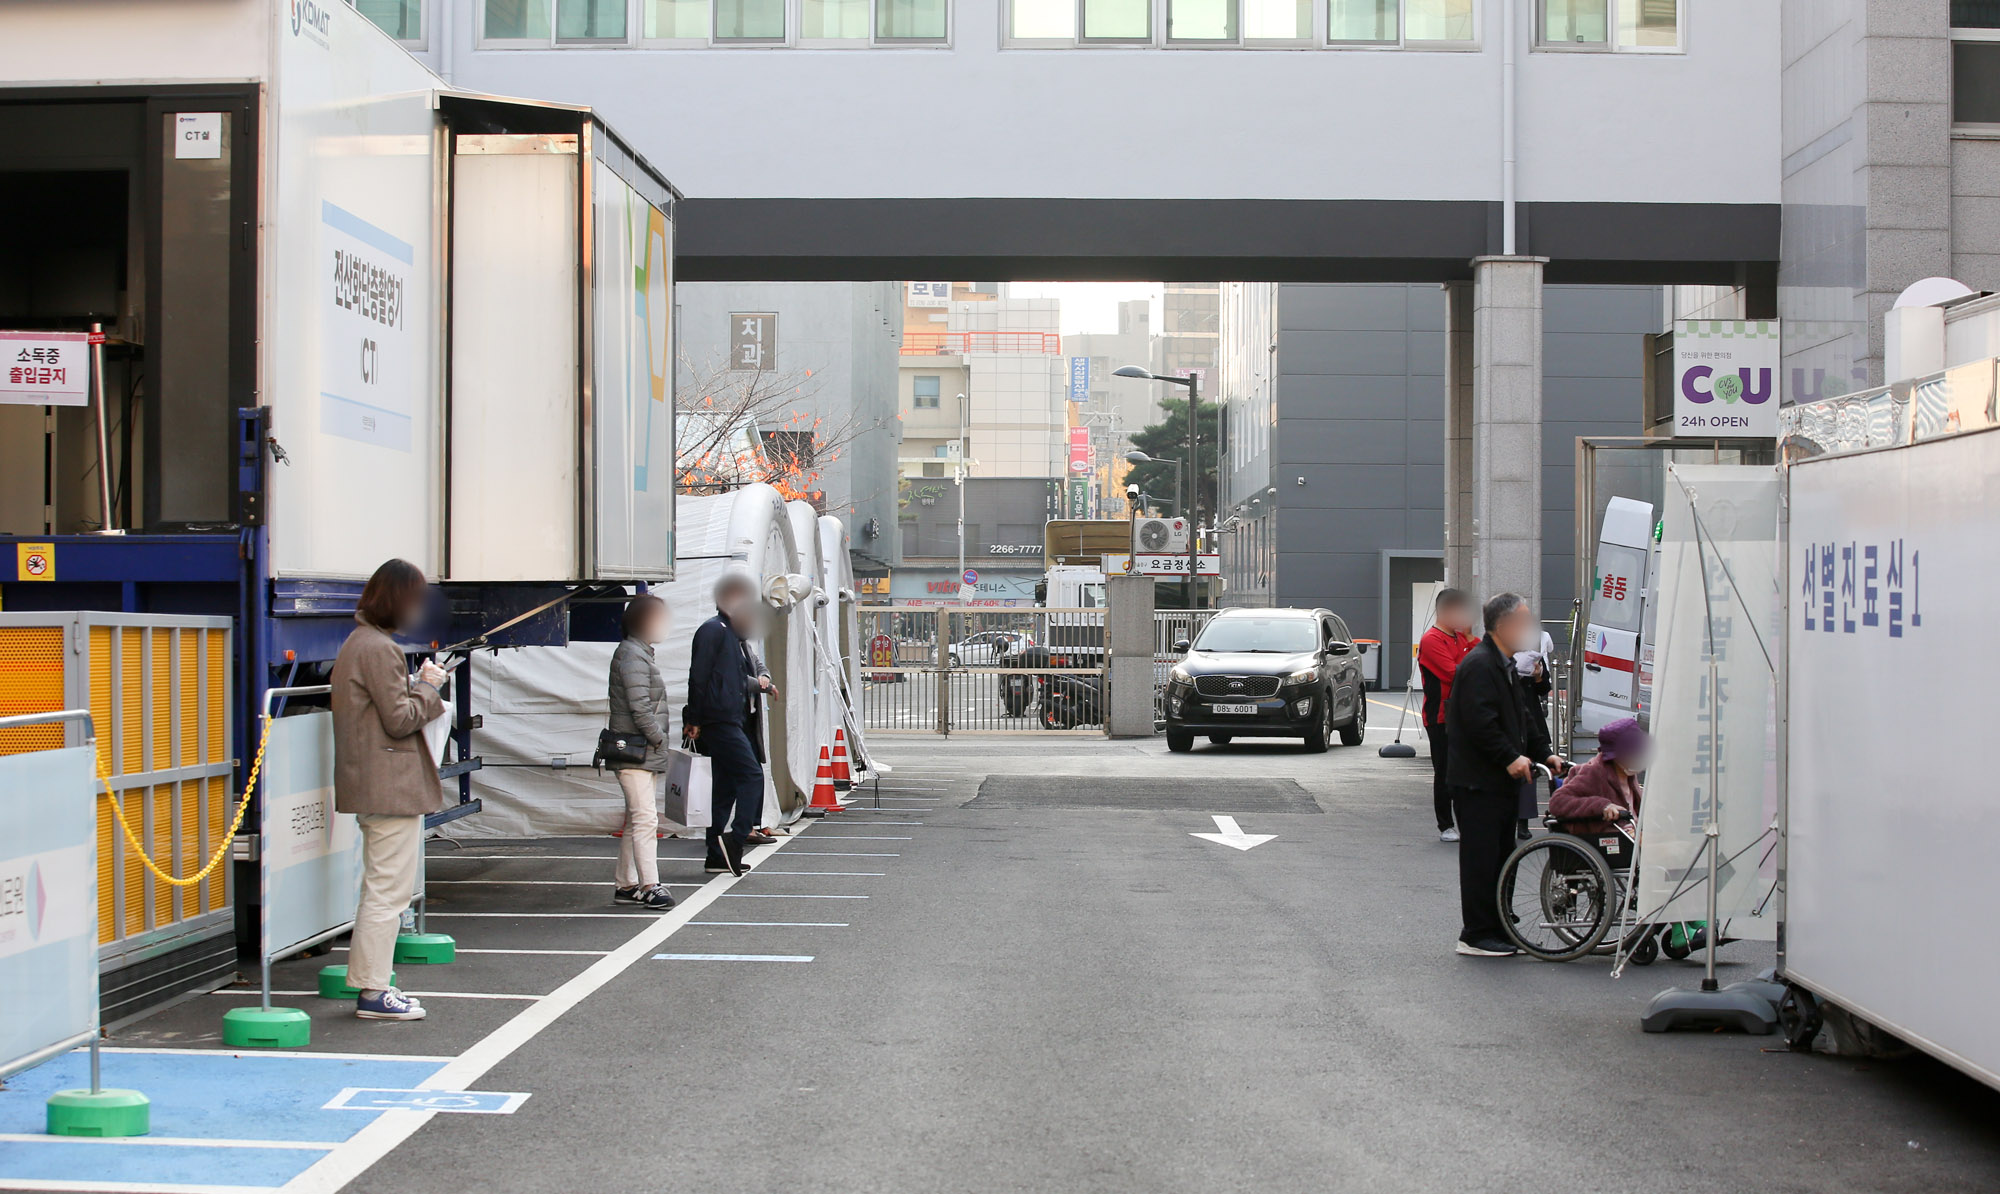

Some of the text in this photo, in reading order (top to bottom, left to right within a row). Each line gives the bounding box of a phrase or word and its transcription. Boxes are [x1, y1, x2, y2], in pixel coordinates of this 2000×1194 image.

[185, 131, 210, 141] CT실
[334, 249, 403, 332] 전산화단층촬영기
[741, 317, 765, 369] 치과
[17, 347, 60, 365] 소독중
[1681, 352, 1732, 360] 당신을 위한 편의점
[9, 366, 66, 385] 출입금지
[1681, 365, 1771, 405] CU
[1681, 416, 1749, 427] 24h OPEN
[989, 544, 1043, 554] 2266-7777
[1602, 573, 1627, 601] 출동
[1234, 705, 1253, 713] 6001
[671, 783, 682, 797] FILA
